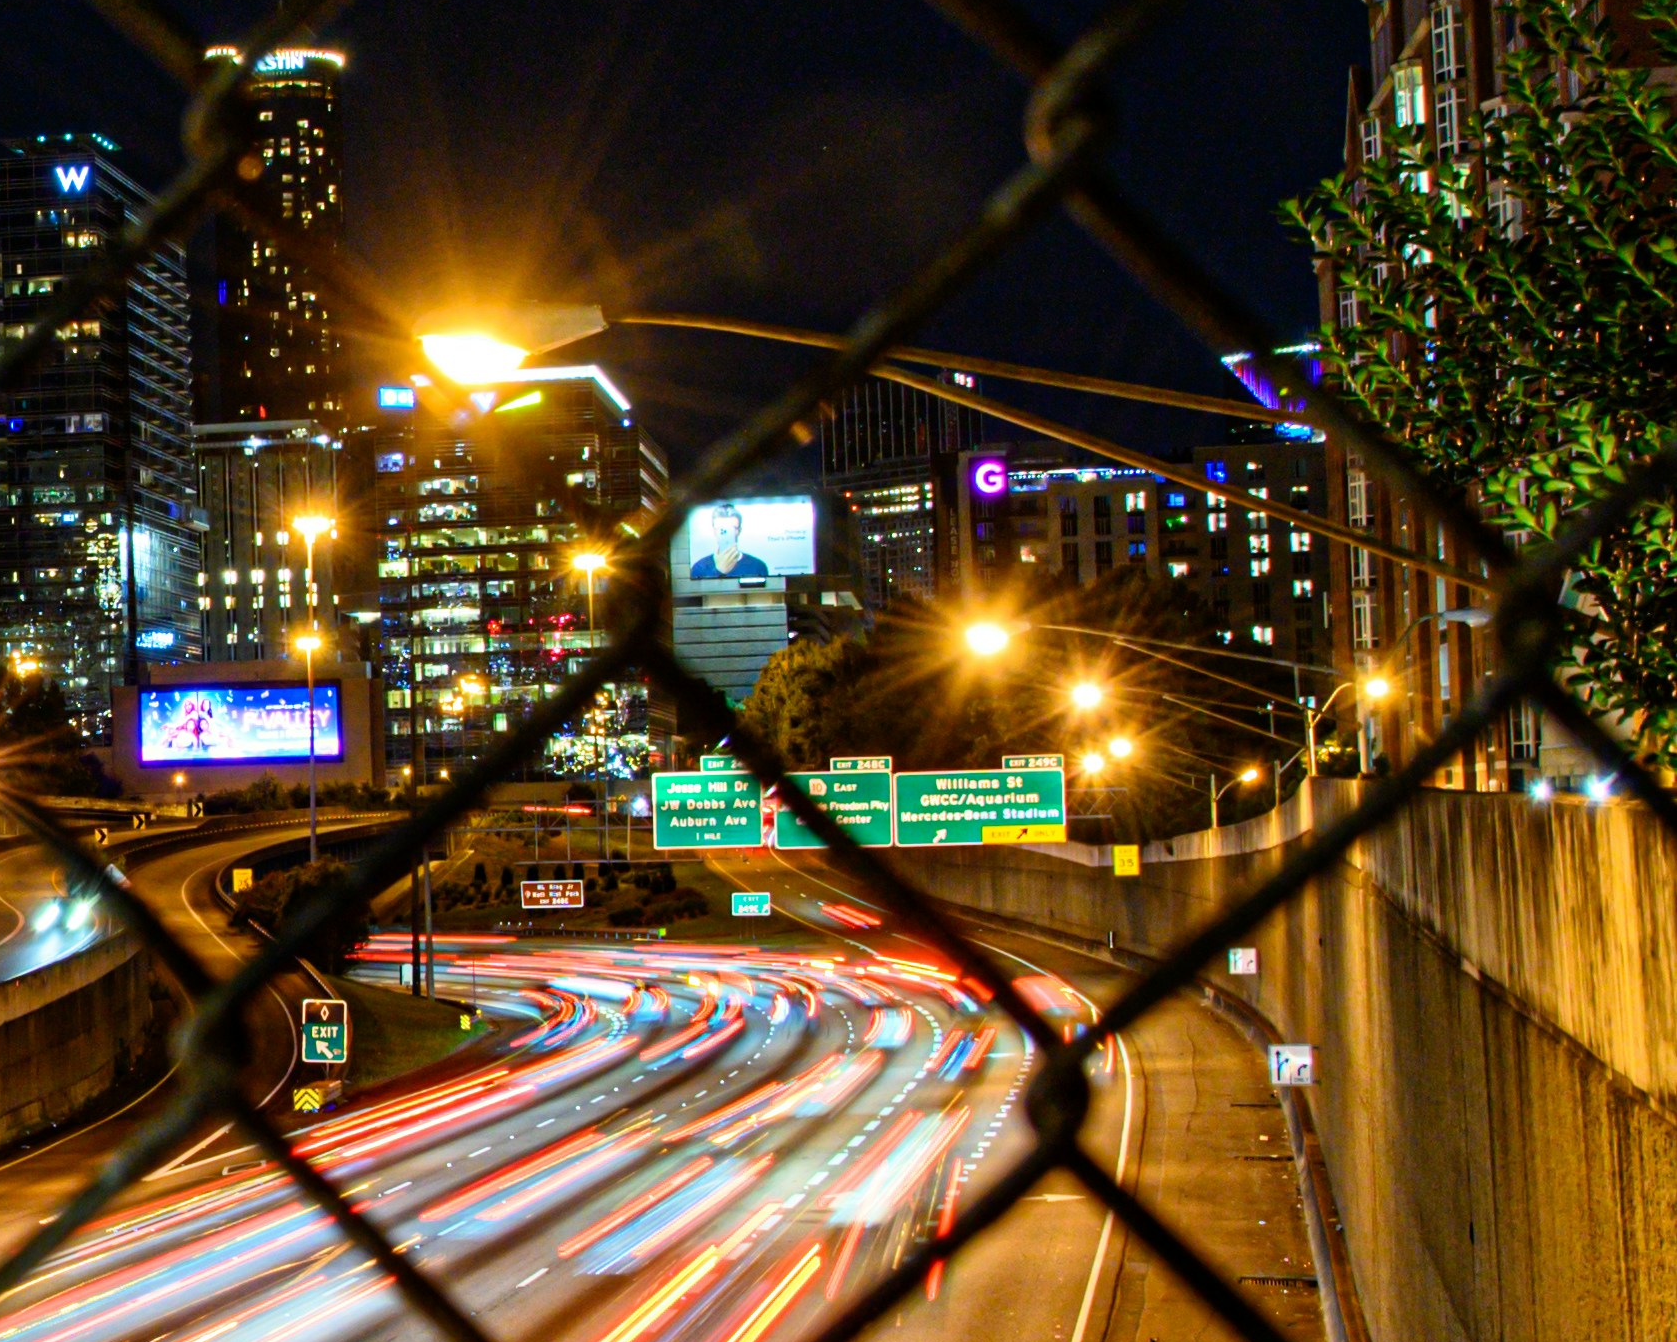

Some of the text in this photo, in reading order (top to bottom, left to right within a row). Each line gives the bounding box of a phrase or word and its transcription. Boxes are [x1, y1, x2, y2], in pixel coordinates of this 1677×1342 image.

[55, 166, 89, 192] W
[975, 463, 1005, 493] G
[1028, 757, 1058, 768] 249C
[666, 780, 749, 794] Jesse Hill Dr
[935, 776, 1023, 790] Williams St
[660, 798, 757, 811] JW Dobbs Ave
[829, 801, 869, 811] Freedom
[920, 792, 1040, 807] GWCC/Aquarium
[669, 815, 747, 827] Auburn Ave
[835, 815, 872, 825] Center
[900, 808, 1060, 823] Mercedes-Benz Stadium
[991, 830, 1056, 839] EXIT ONLY
[311, 1025, 339, 1039] EXIT
